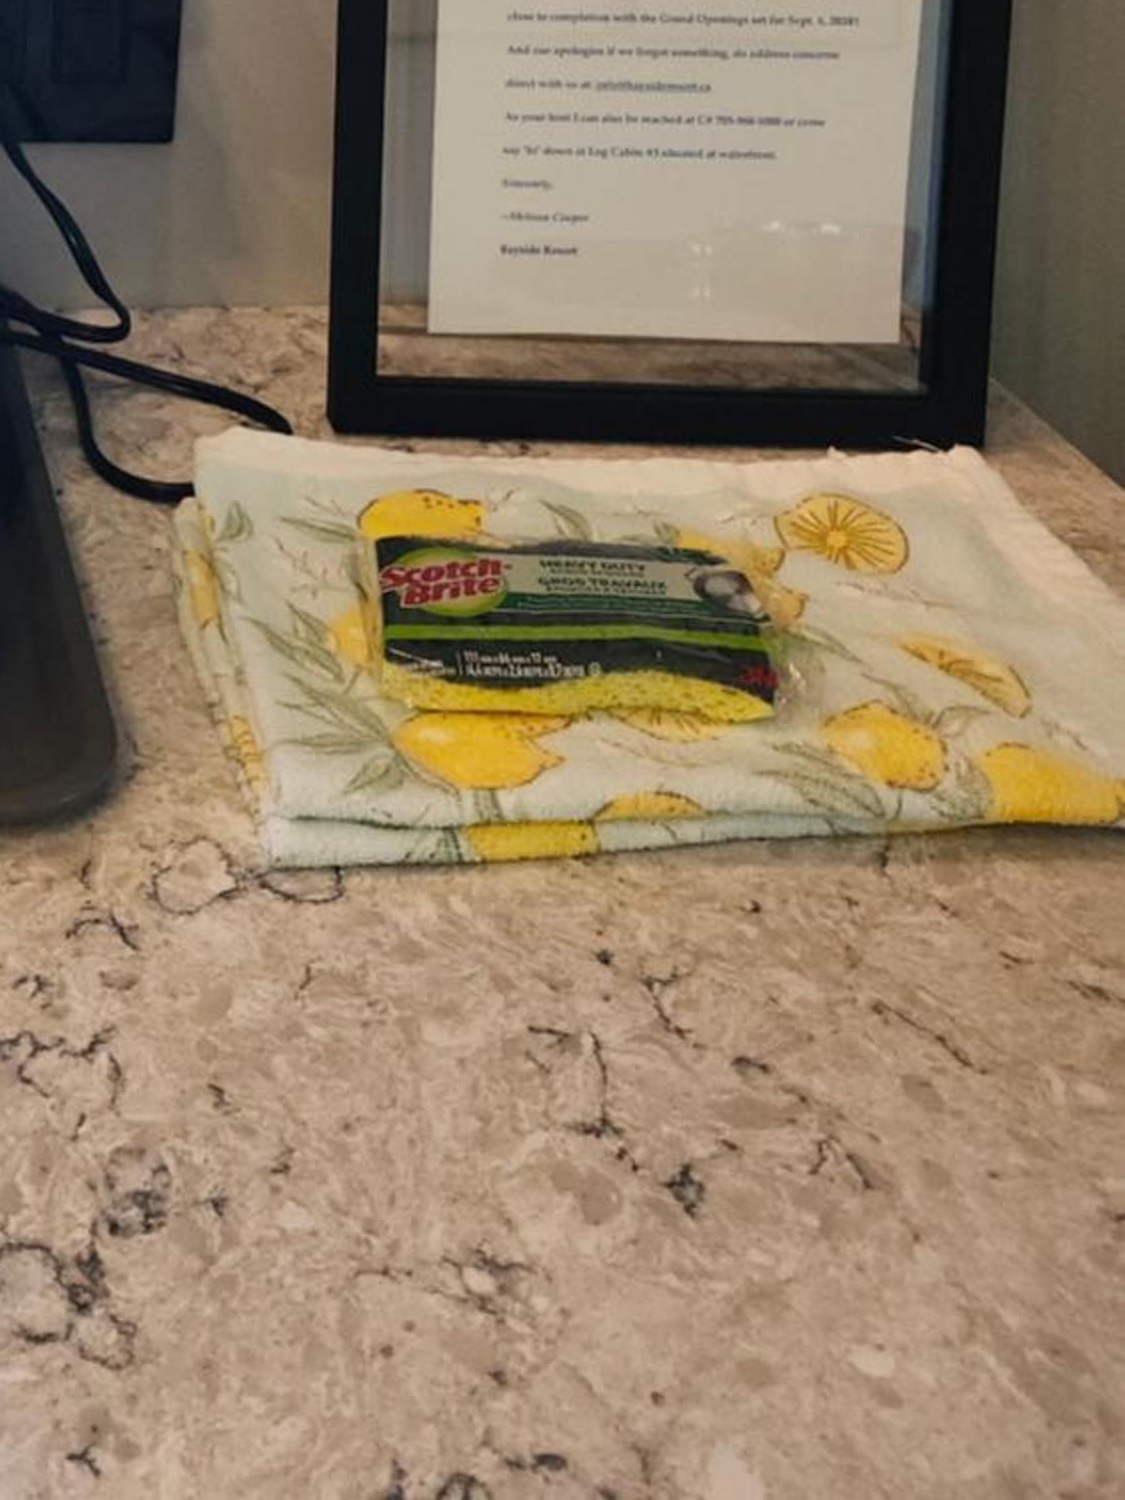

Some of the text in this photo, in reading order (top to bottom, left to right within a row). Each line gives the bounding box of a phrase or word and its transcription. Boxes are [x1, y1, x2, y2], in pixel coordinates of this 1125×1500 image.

[500, 244, 578, 257] Bayside Resort
[401, 576, 502, 607] Brite
